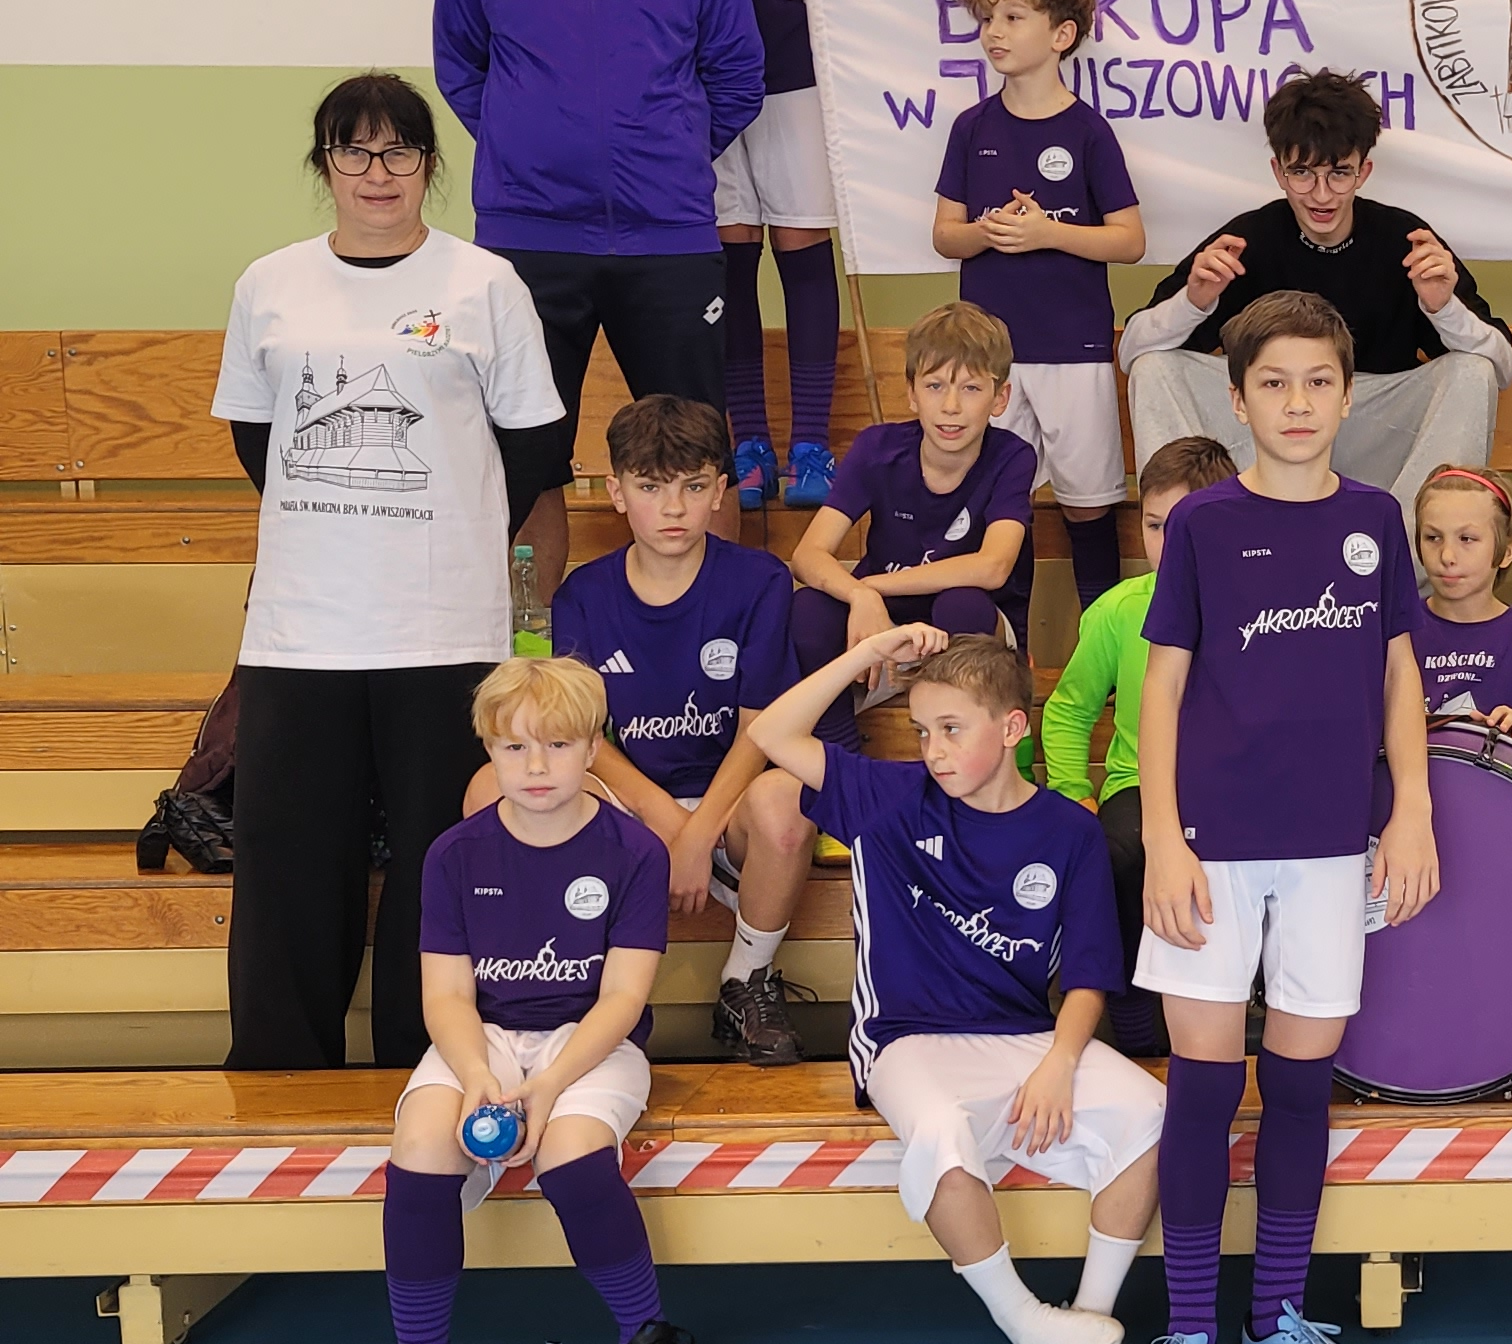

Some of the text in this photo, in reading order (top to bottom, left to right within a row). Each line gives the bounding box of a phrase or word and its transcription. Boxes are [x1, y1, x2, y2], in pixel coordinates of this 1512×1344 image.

[343, 503, 358, 515] BPA
[361, 504, 369, 516] W
[371, 505, 434, 521] JAWISZOWICACH
[1242, 548, 1272, 558] KIPSTA
[1244, 600, 1371, 640] AKROPROCES
[1424, 650, 1496, 669] KOŚCIÓŁ
[474, 887, 503, 896] KIPSTA
[474, 950, 596, 981] AKROPROCES
